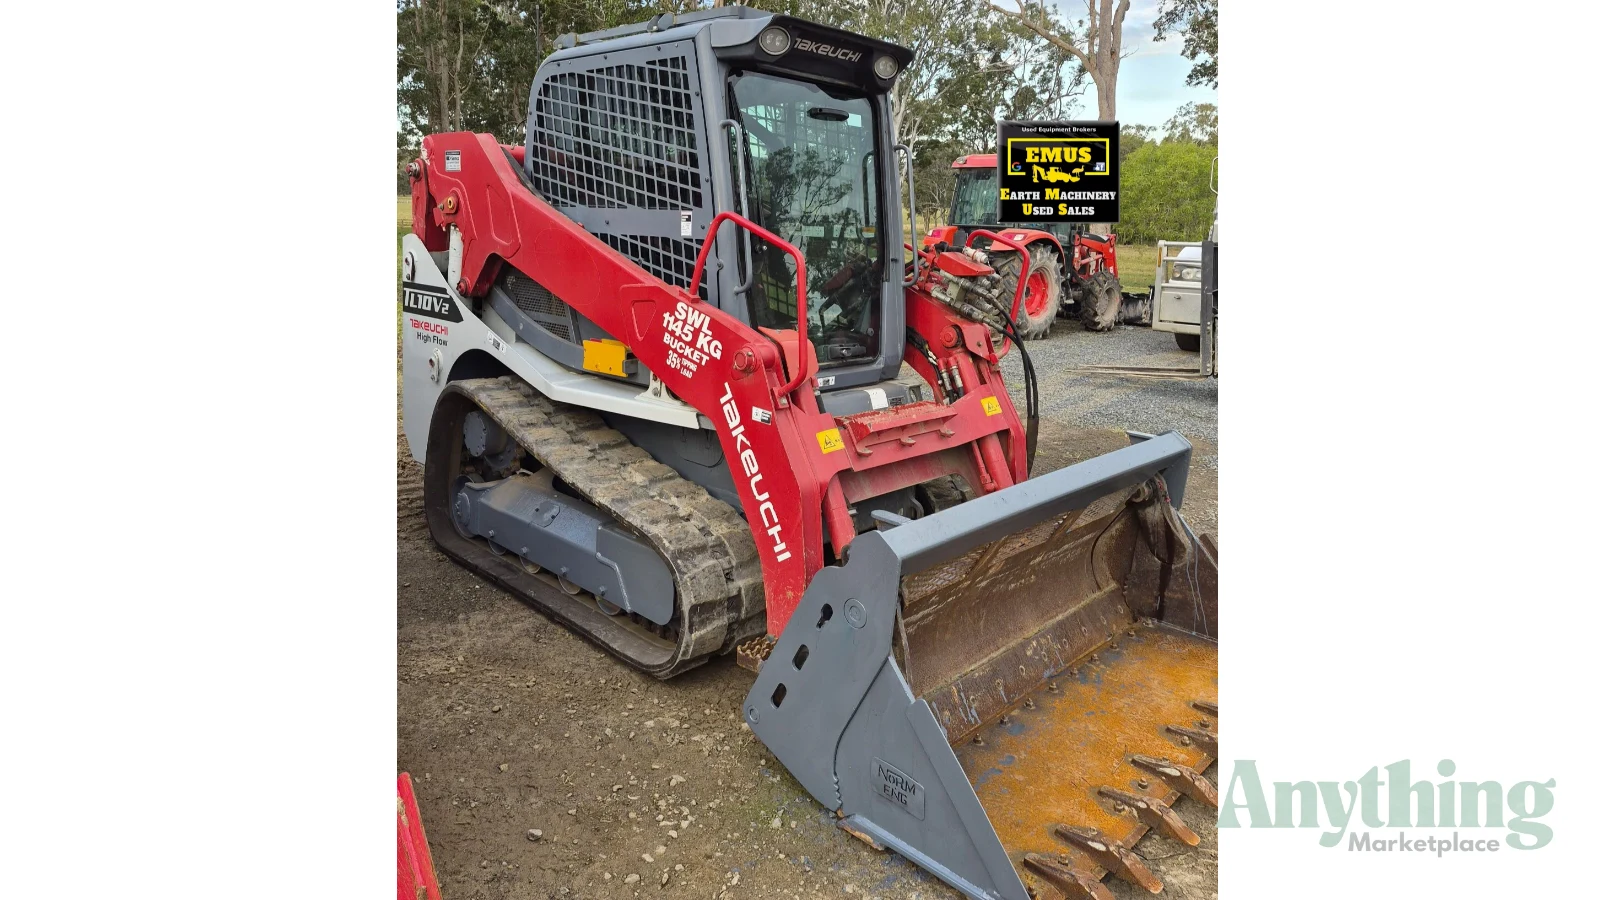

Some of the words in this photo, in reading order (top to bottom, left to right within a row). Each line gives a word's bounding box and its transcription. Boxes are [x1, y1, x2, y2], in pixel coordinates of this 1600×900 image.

[793, 37, 862, 63] TAKEUCHI
[403, 287, 450, 315] TL10V2
[409, 318, 449, 336] TAKEUCHI
[674, 301, 713, 336] SWL
[416, 331, 432, 344] High
[432, 335, 449, 347] Flow
[662, 311, 695, 342] 1145
[696, 331, 723, 360] KG
[663, 331, 710, 366] BUCKET
[680, 367, 693, 379] LOAD
[719, 381, 792, 563] TAKEUCHI
[883, 783, 908, 806] ENG
